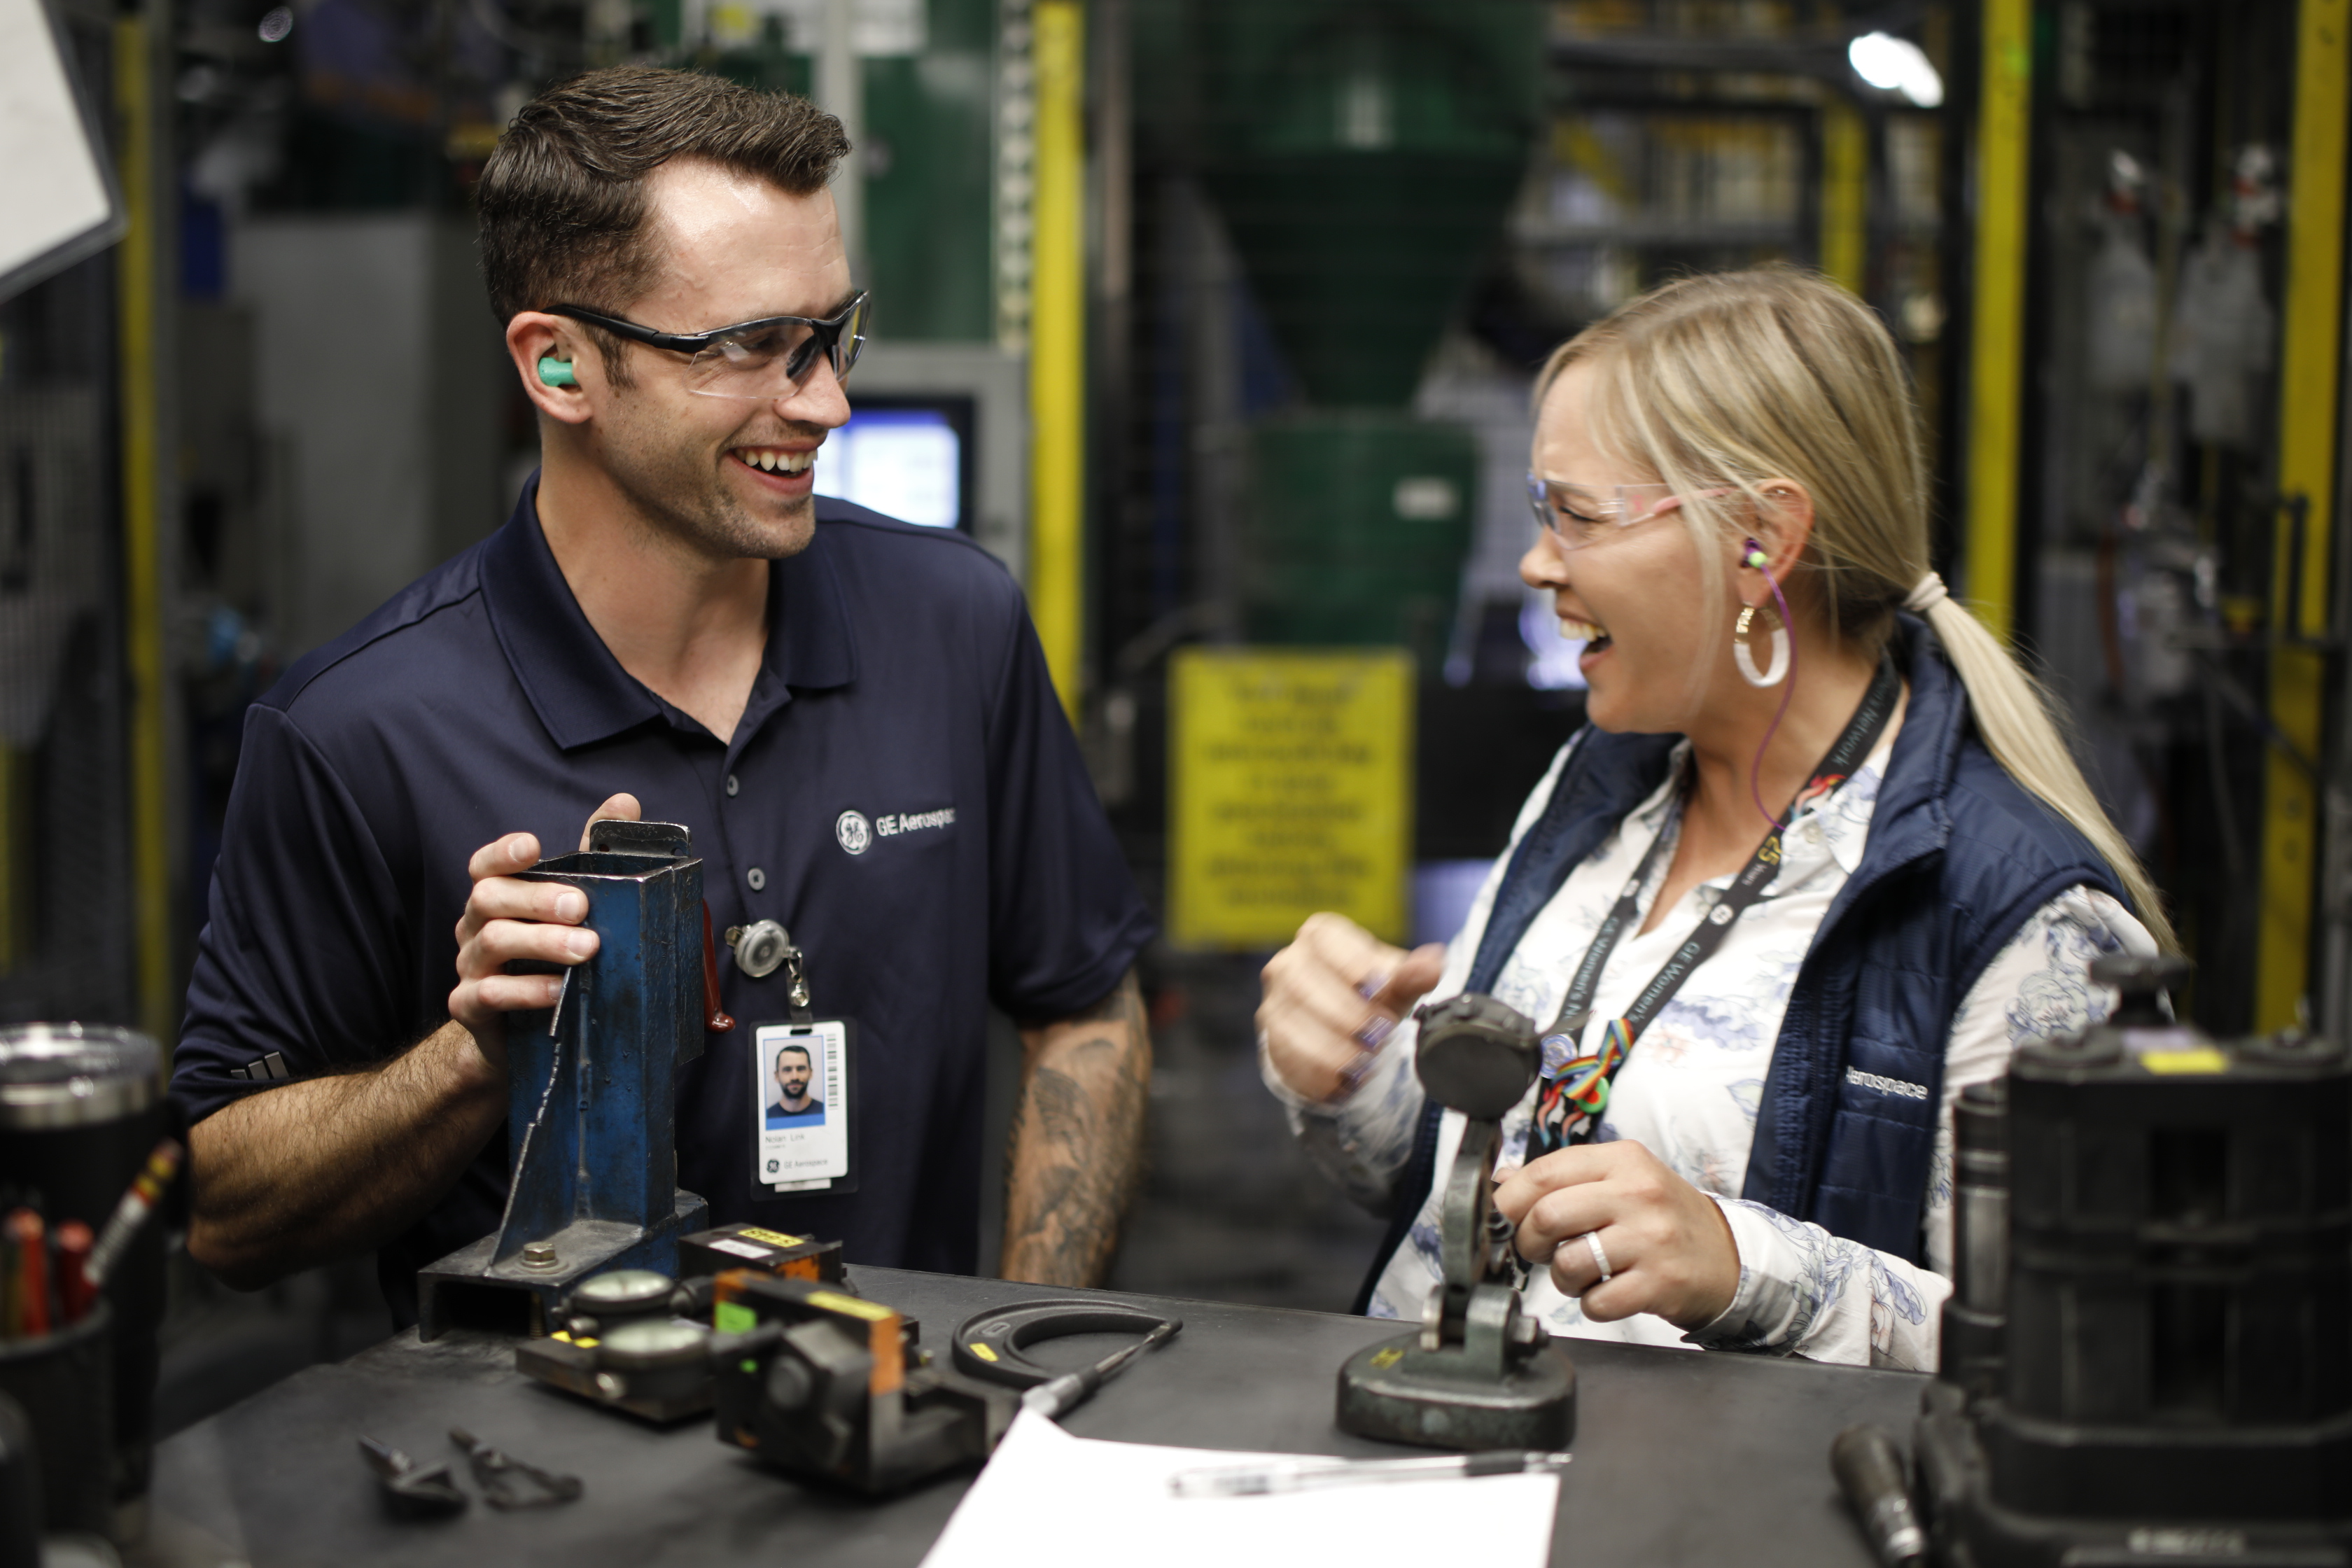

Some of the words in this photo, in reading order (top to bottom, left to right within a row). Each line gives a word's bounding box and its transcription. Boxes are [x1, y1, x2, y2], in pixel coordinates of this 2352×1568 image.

[1831, 708, 1879, 767] Network
[876, 814, 899, 836] GE
[1758, 836, 1783, 866] 25
[1679, 941, 1701, 964] GE
[1627, 962, 1686, 1023] Women's
